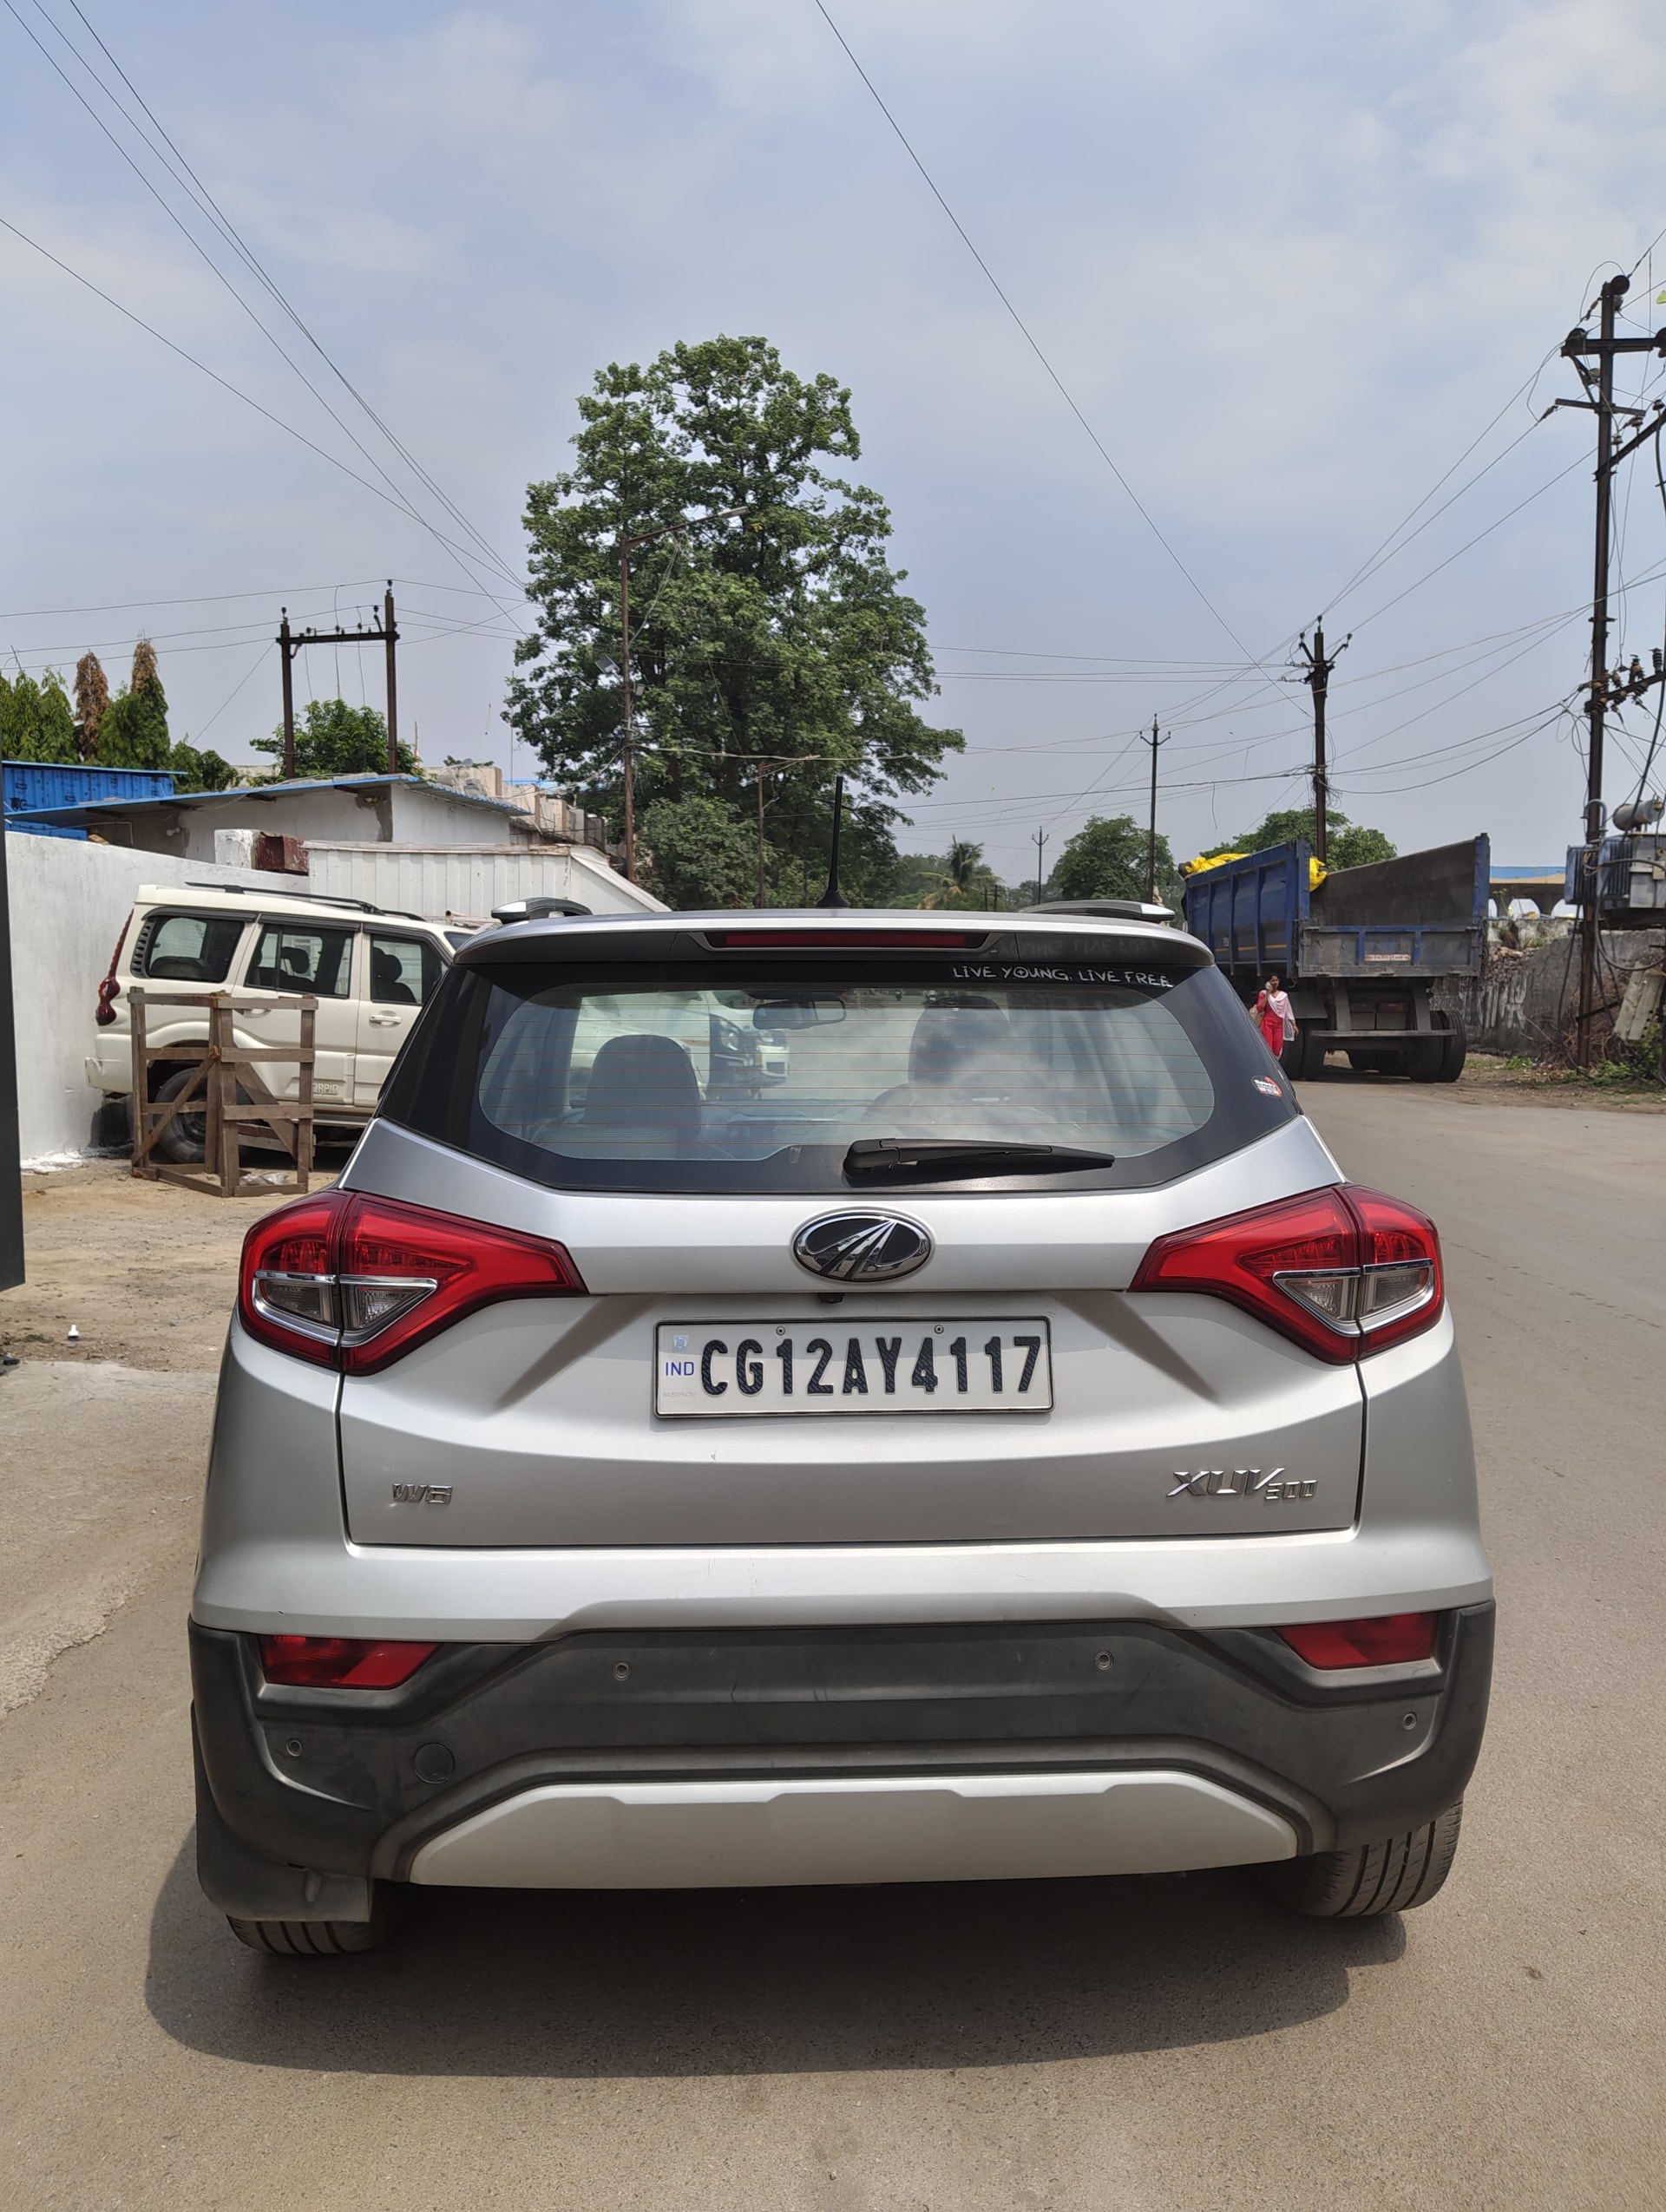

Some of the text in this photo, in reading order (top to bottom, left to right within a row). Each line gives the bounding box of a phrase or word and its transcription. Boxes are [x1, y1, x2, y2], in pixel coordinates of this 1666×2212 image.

[952, 965, 997, 978] LIVE
[1078, 969, 1121, 982] LIVE
[1124, 972, 1174, 988] FREE
[666, 1361, 695, 1377] IND
[701, 1336, 1041, 1397] CG12AY4117
